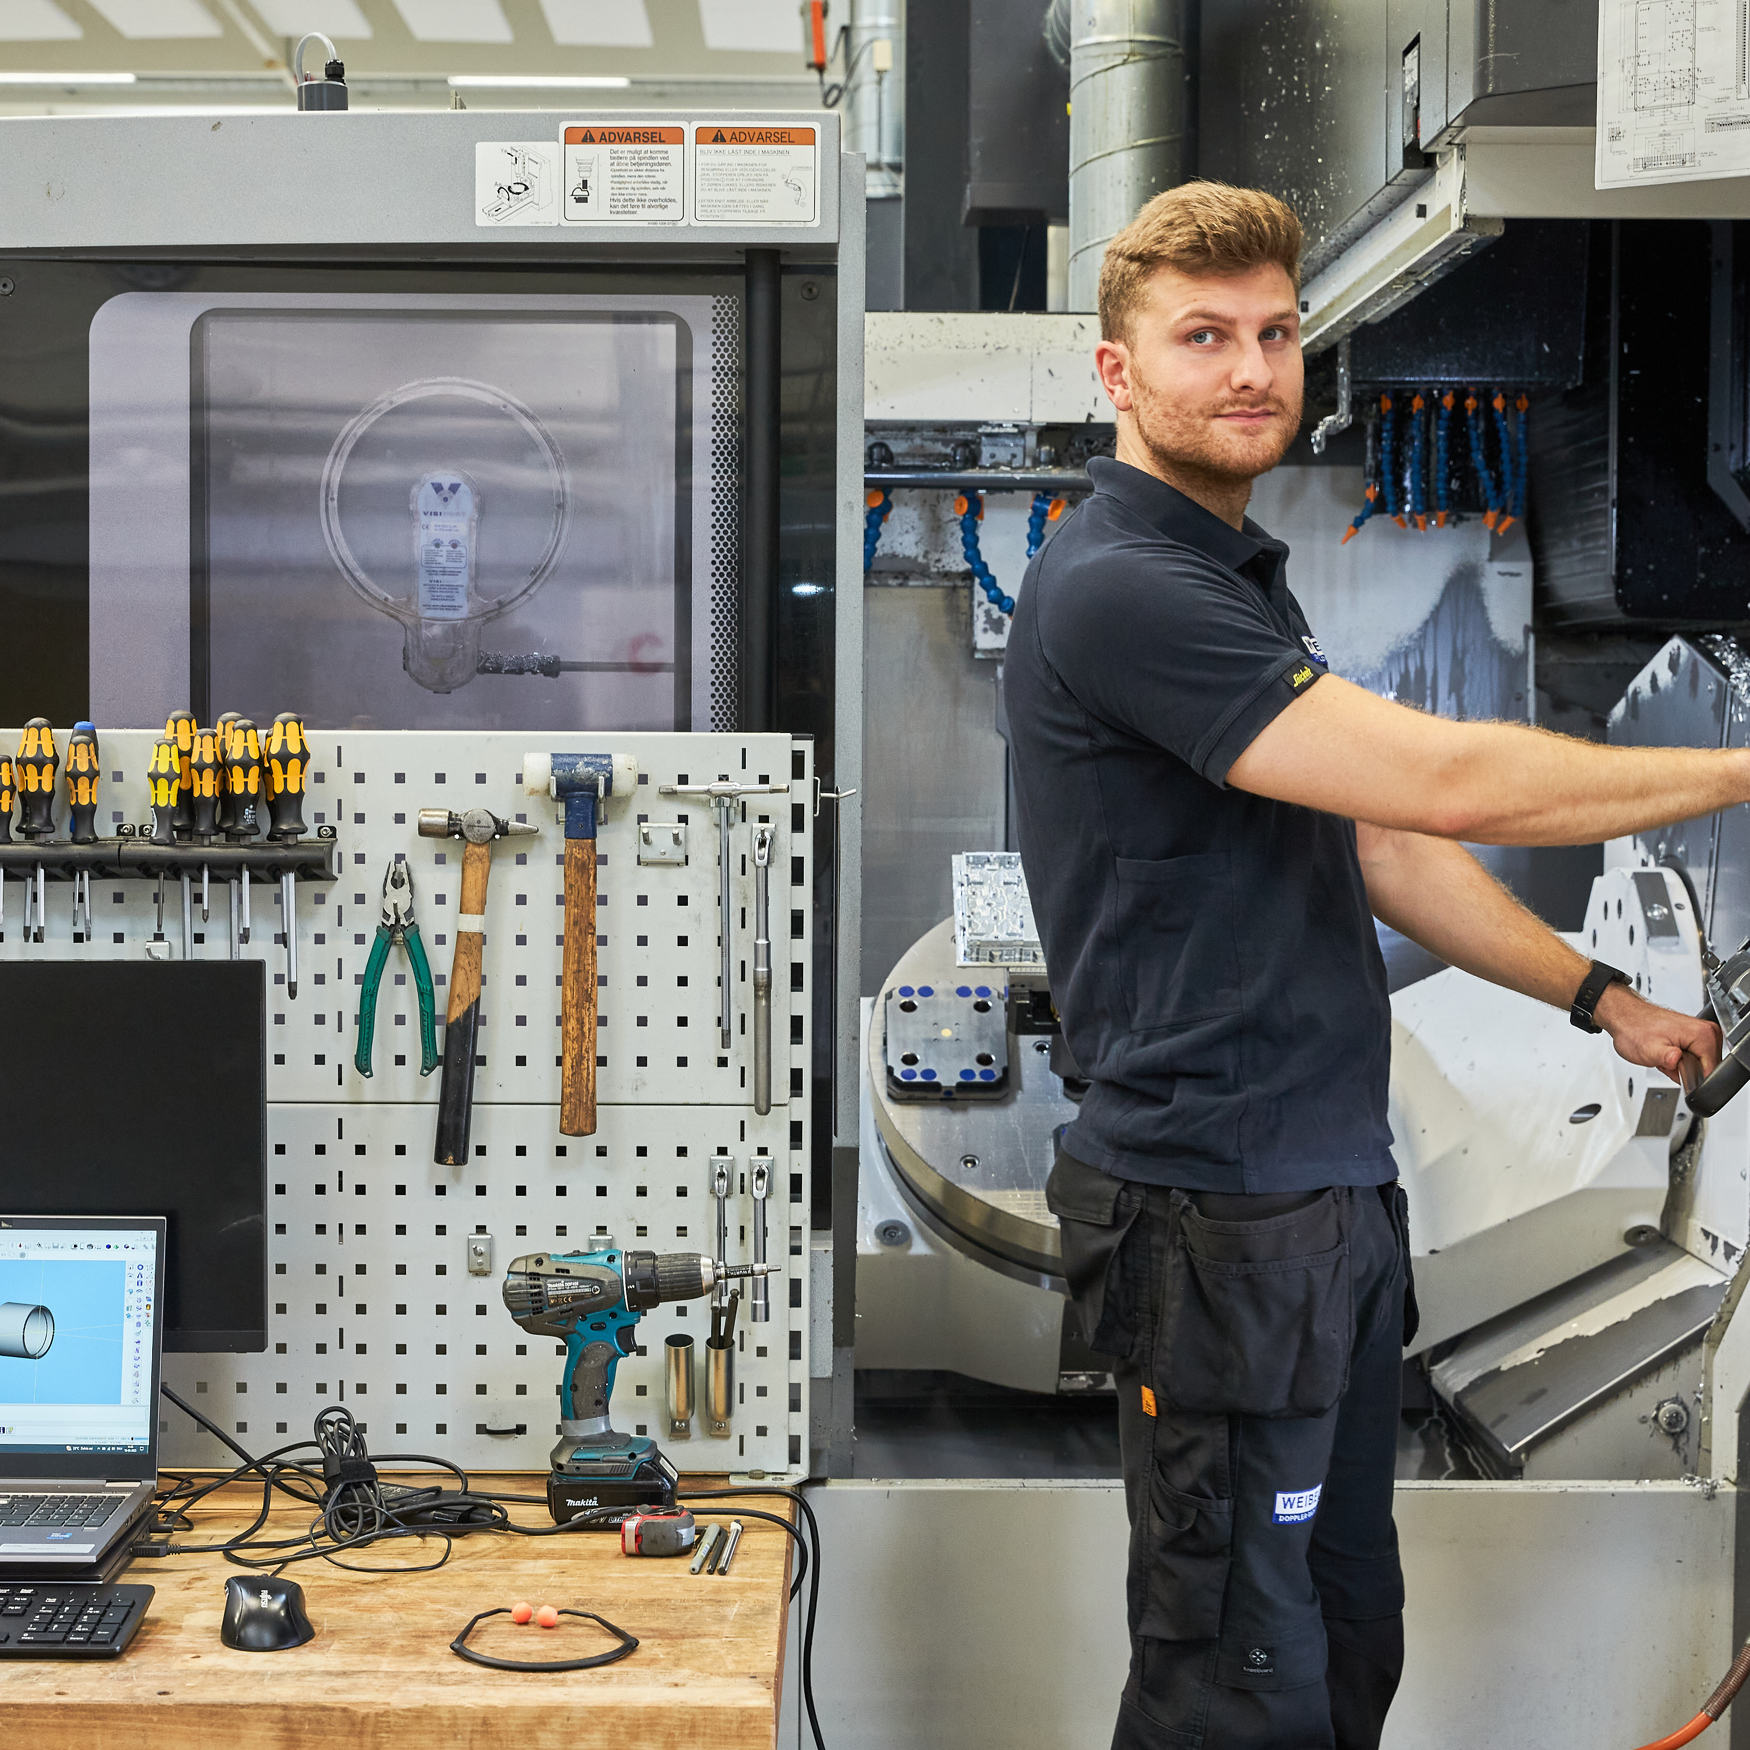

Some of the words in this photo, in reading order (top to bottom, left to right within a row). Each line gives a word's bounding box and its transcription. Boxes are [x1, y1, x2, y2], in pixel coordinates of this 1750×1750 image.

[599, 132, 665, 142] ADVARSEL
[729, 132, 795, 143] ADVARSEL
[566, 1498, 598, 1506] Makita
[1279, 1512, 1308, 1522] DOPPLER
[260, 1590, 272, 1608] FUJITSU
